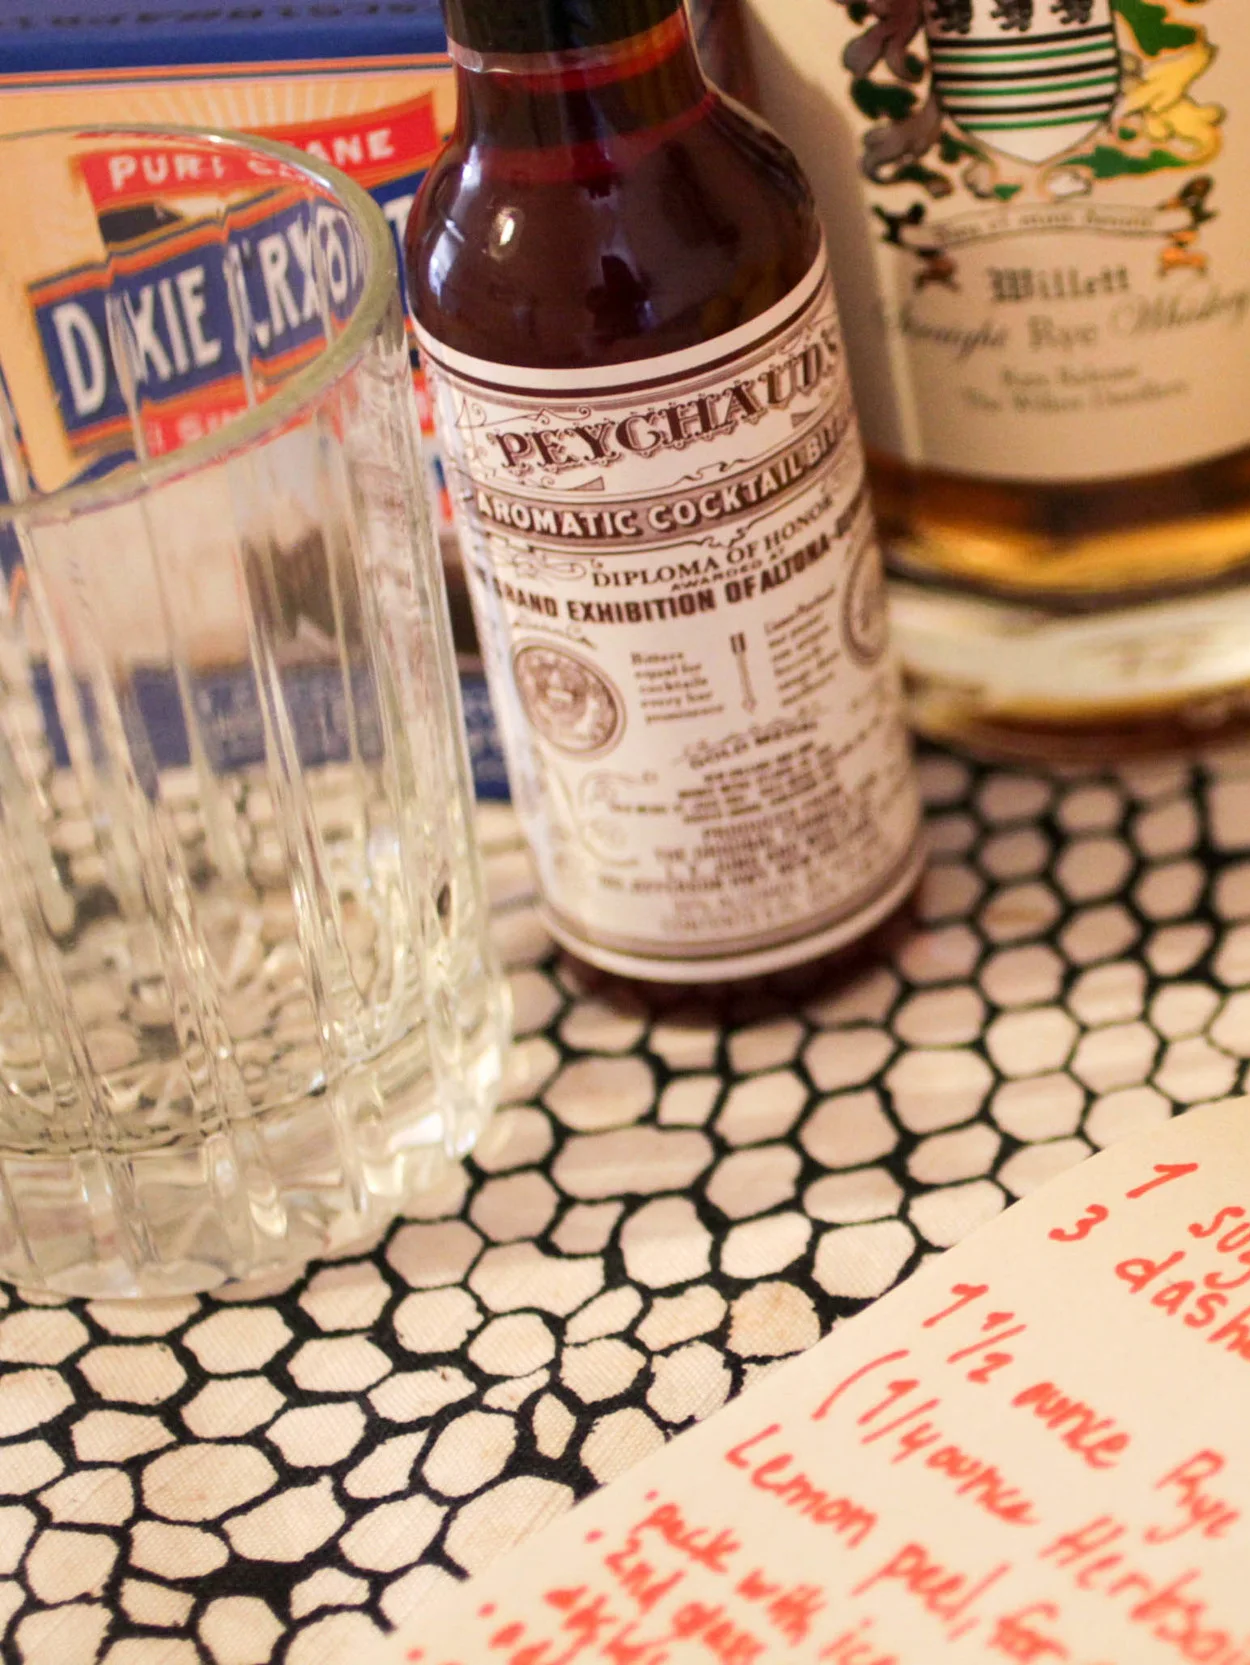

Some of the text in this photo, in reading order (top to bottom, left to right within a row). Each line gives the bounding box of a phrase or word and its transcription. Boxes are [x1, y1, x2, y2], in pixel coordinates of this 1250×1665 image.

[988, 264, 1130, 302] Willett
[1028, 314, 1097, 352] Rye
[476, 490, 640, 537] AROMATIC
[648, 455, 803, 531] COCKTAIL
[592, 556, 719, 587] DIPLOMA
[726, 544, 757, 564] OF
[671, 559, 762, 592] AWARDED
[566, 588, 716, 623] EXHIBITION
[724, 573, 757, 603] OF
[1125, 1161, 1200, 1200] 1
[1048, 1203, 1109, 1242] 3
[1010, 1380, 1131, 1470] ounce
[1143, 1449, 1243, 1545] Rye
[725, 1422, 878, 1550] Lemon
